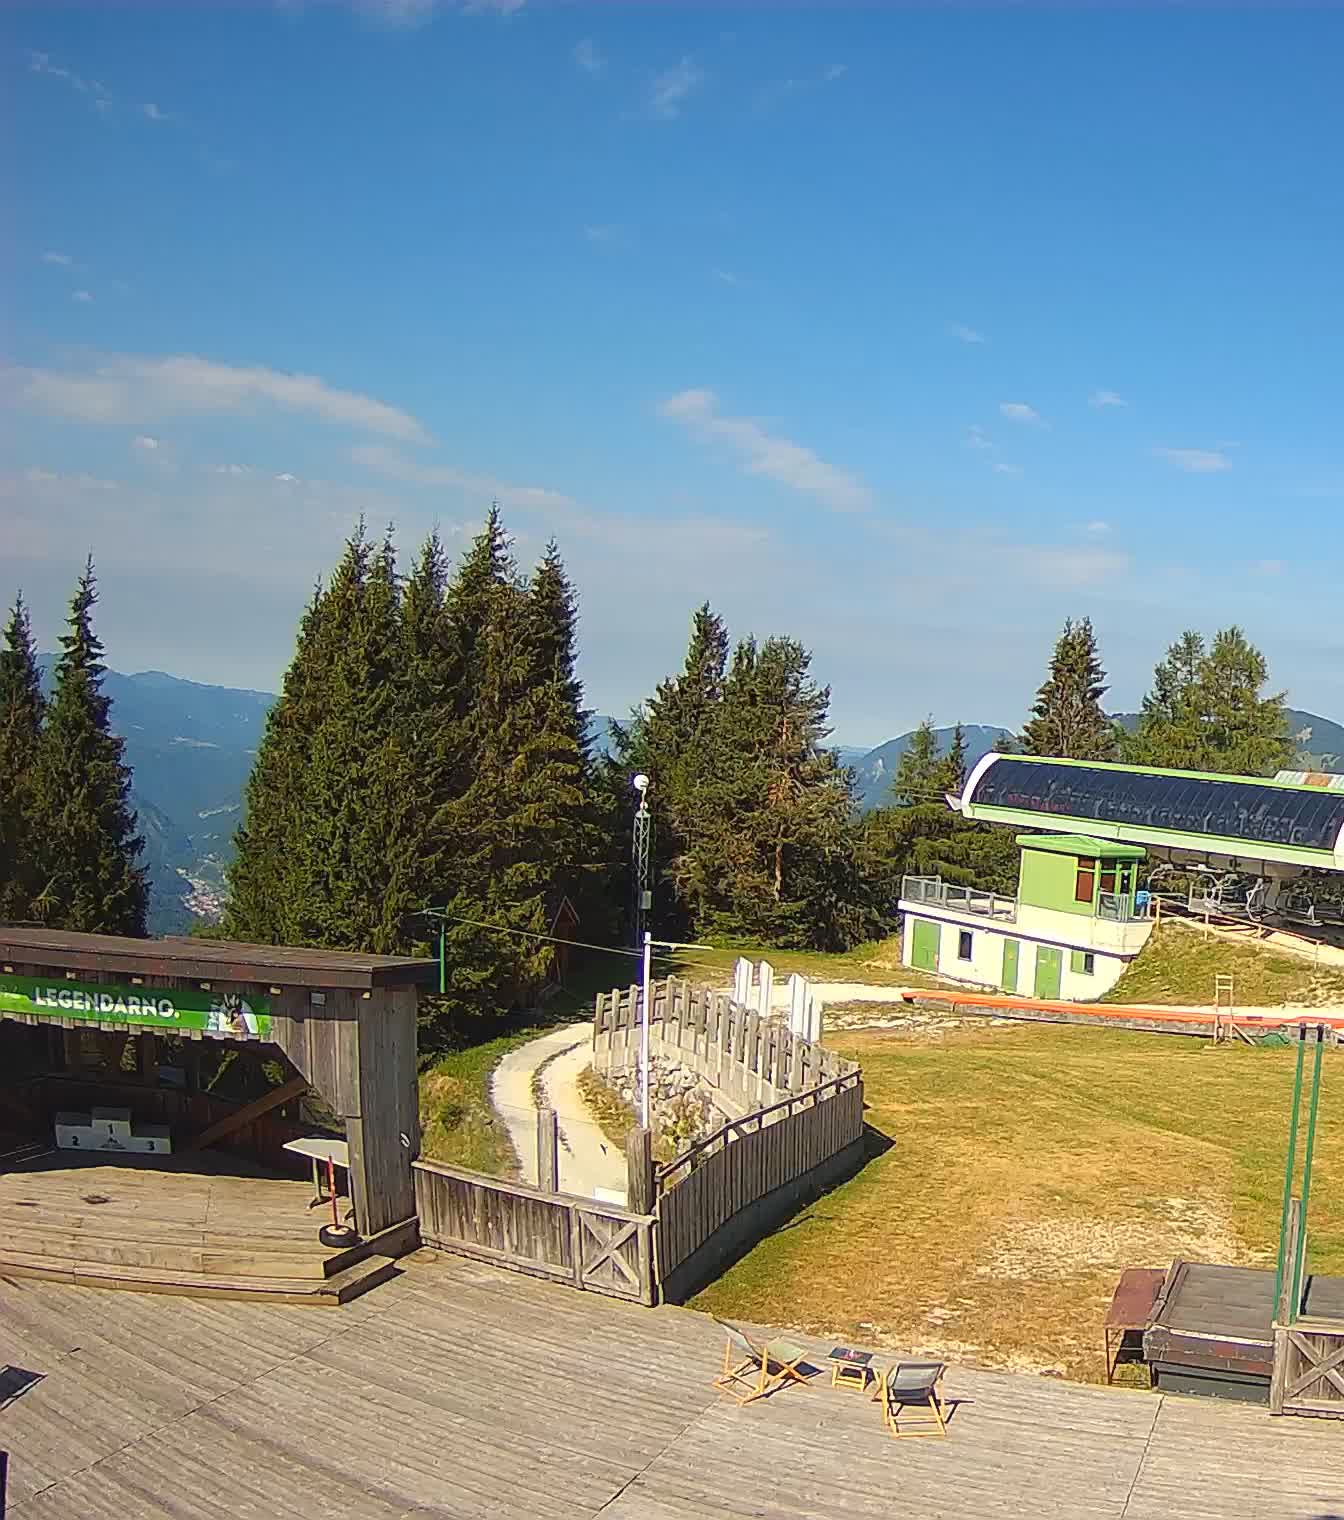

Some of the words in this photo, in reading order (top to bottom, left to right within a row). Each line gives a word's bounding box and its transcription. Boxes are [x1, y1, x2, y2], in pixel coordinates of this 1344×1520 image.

[34, 986, 182, 1019] LEGENDARNO.
[107, 1123, 114, 1135] 1
[71, 1135, 79, 1146] 2
[147, 1140, 155, 1151] 3
